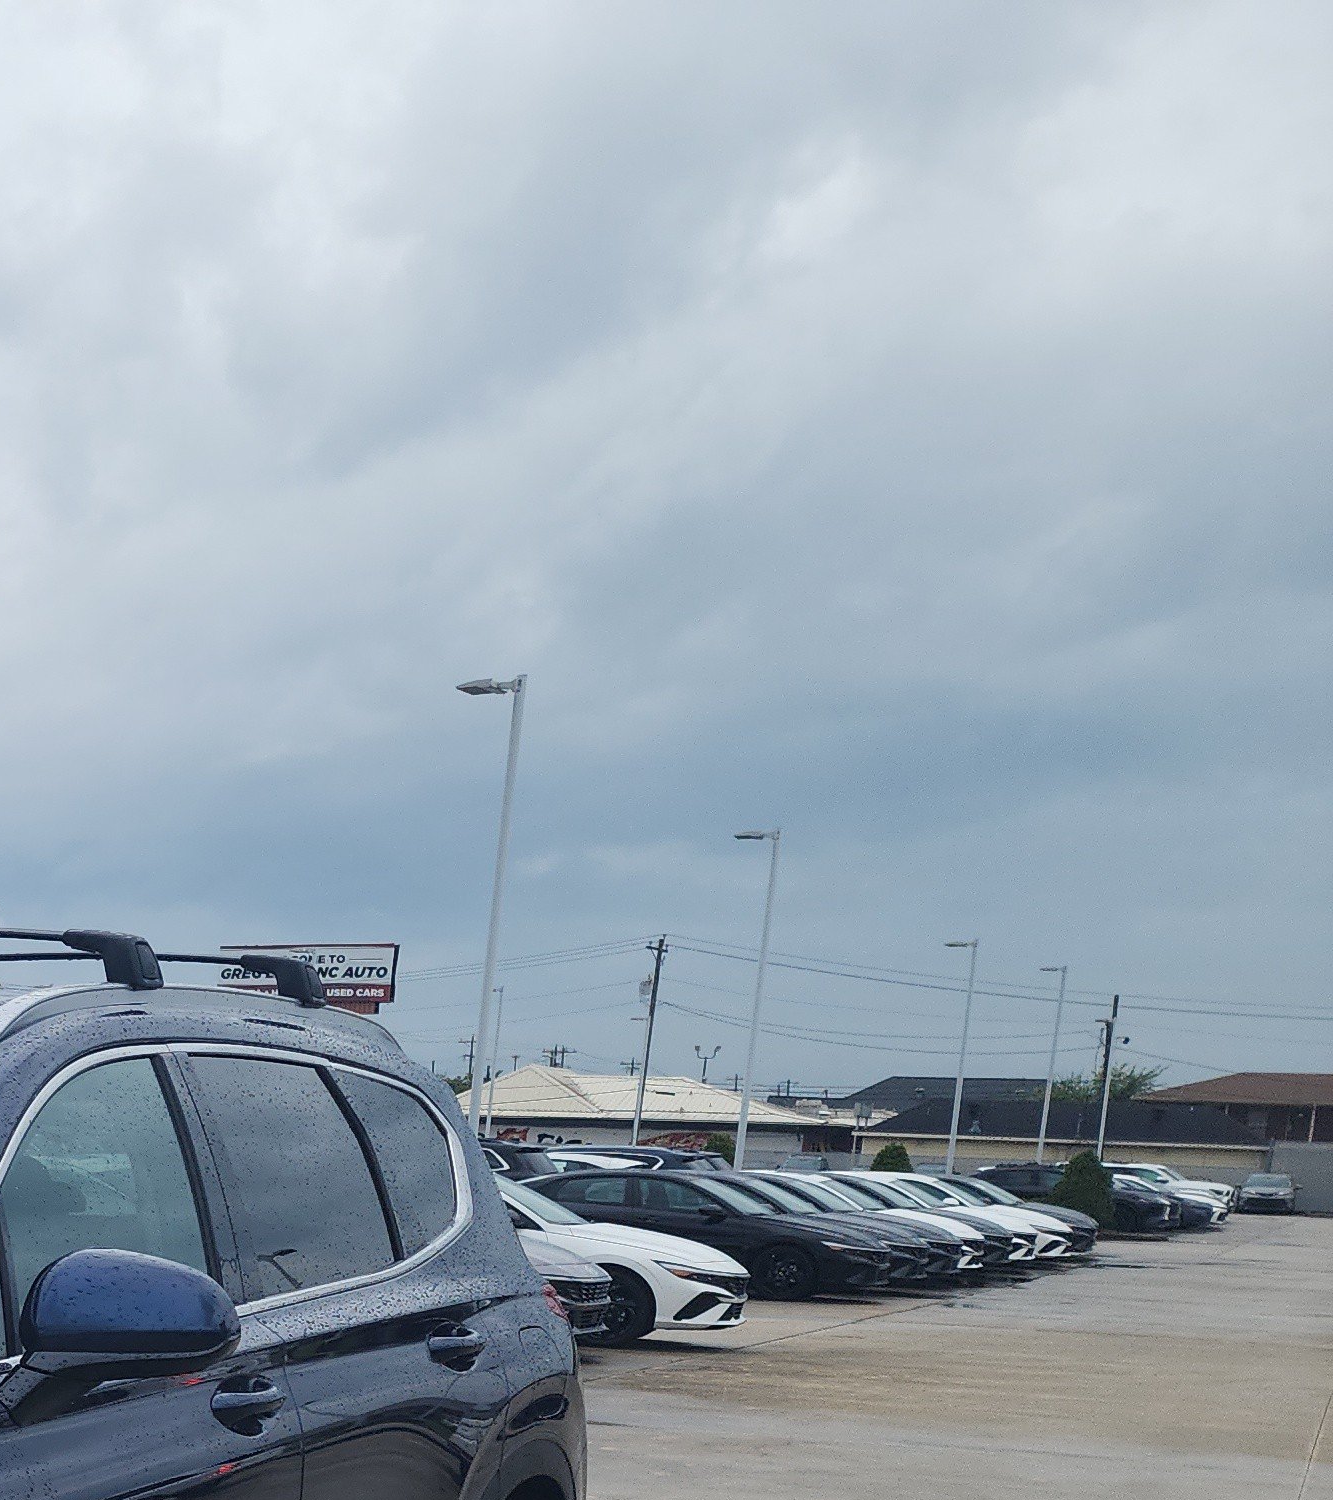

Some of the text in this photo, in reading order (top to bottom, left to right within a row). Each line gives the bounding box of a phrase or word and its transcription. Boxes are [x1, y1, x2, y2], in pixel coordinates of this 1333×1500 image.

[329, 955, 346, 964] TO
[341, 966, 389, 979] AUTO
[326, 988, 385, 997] USED CARS
